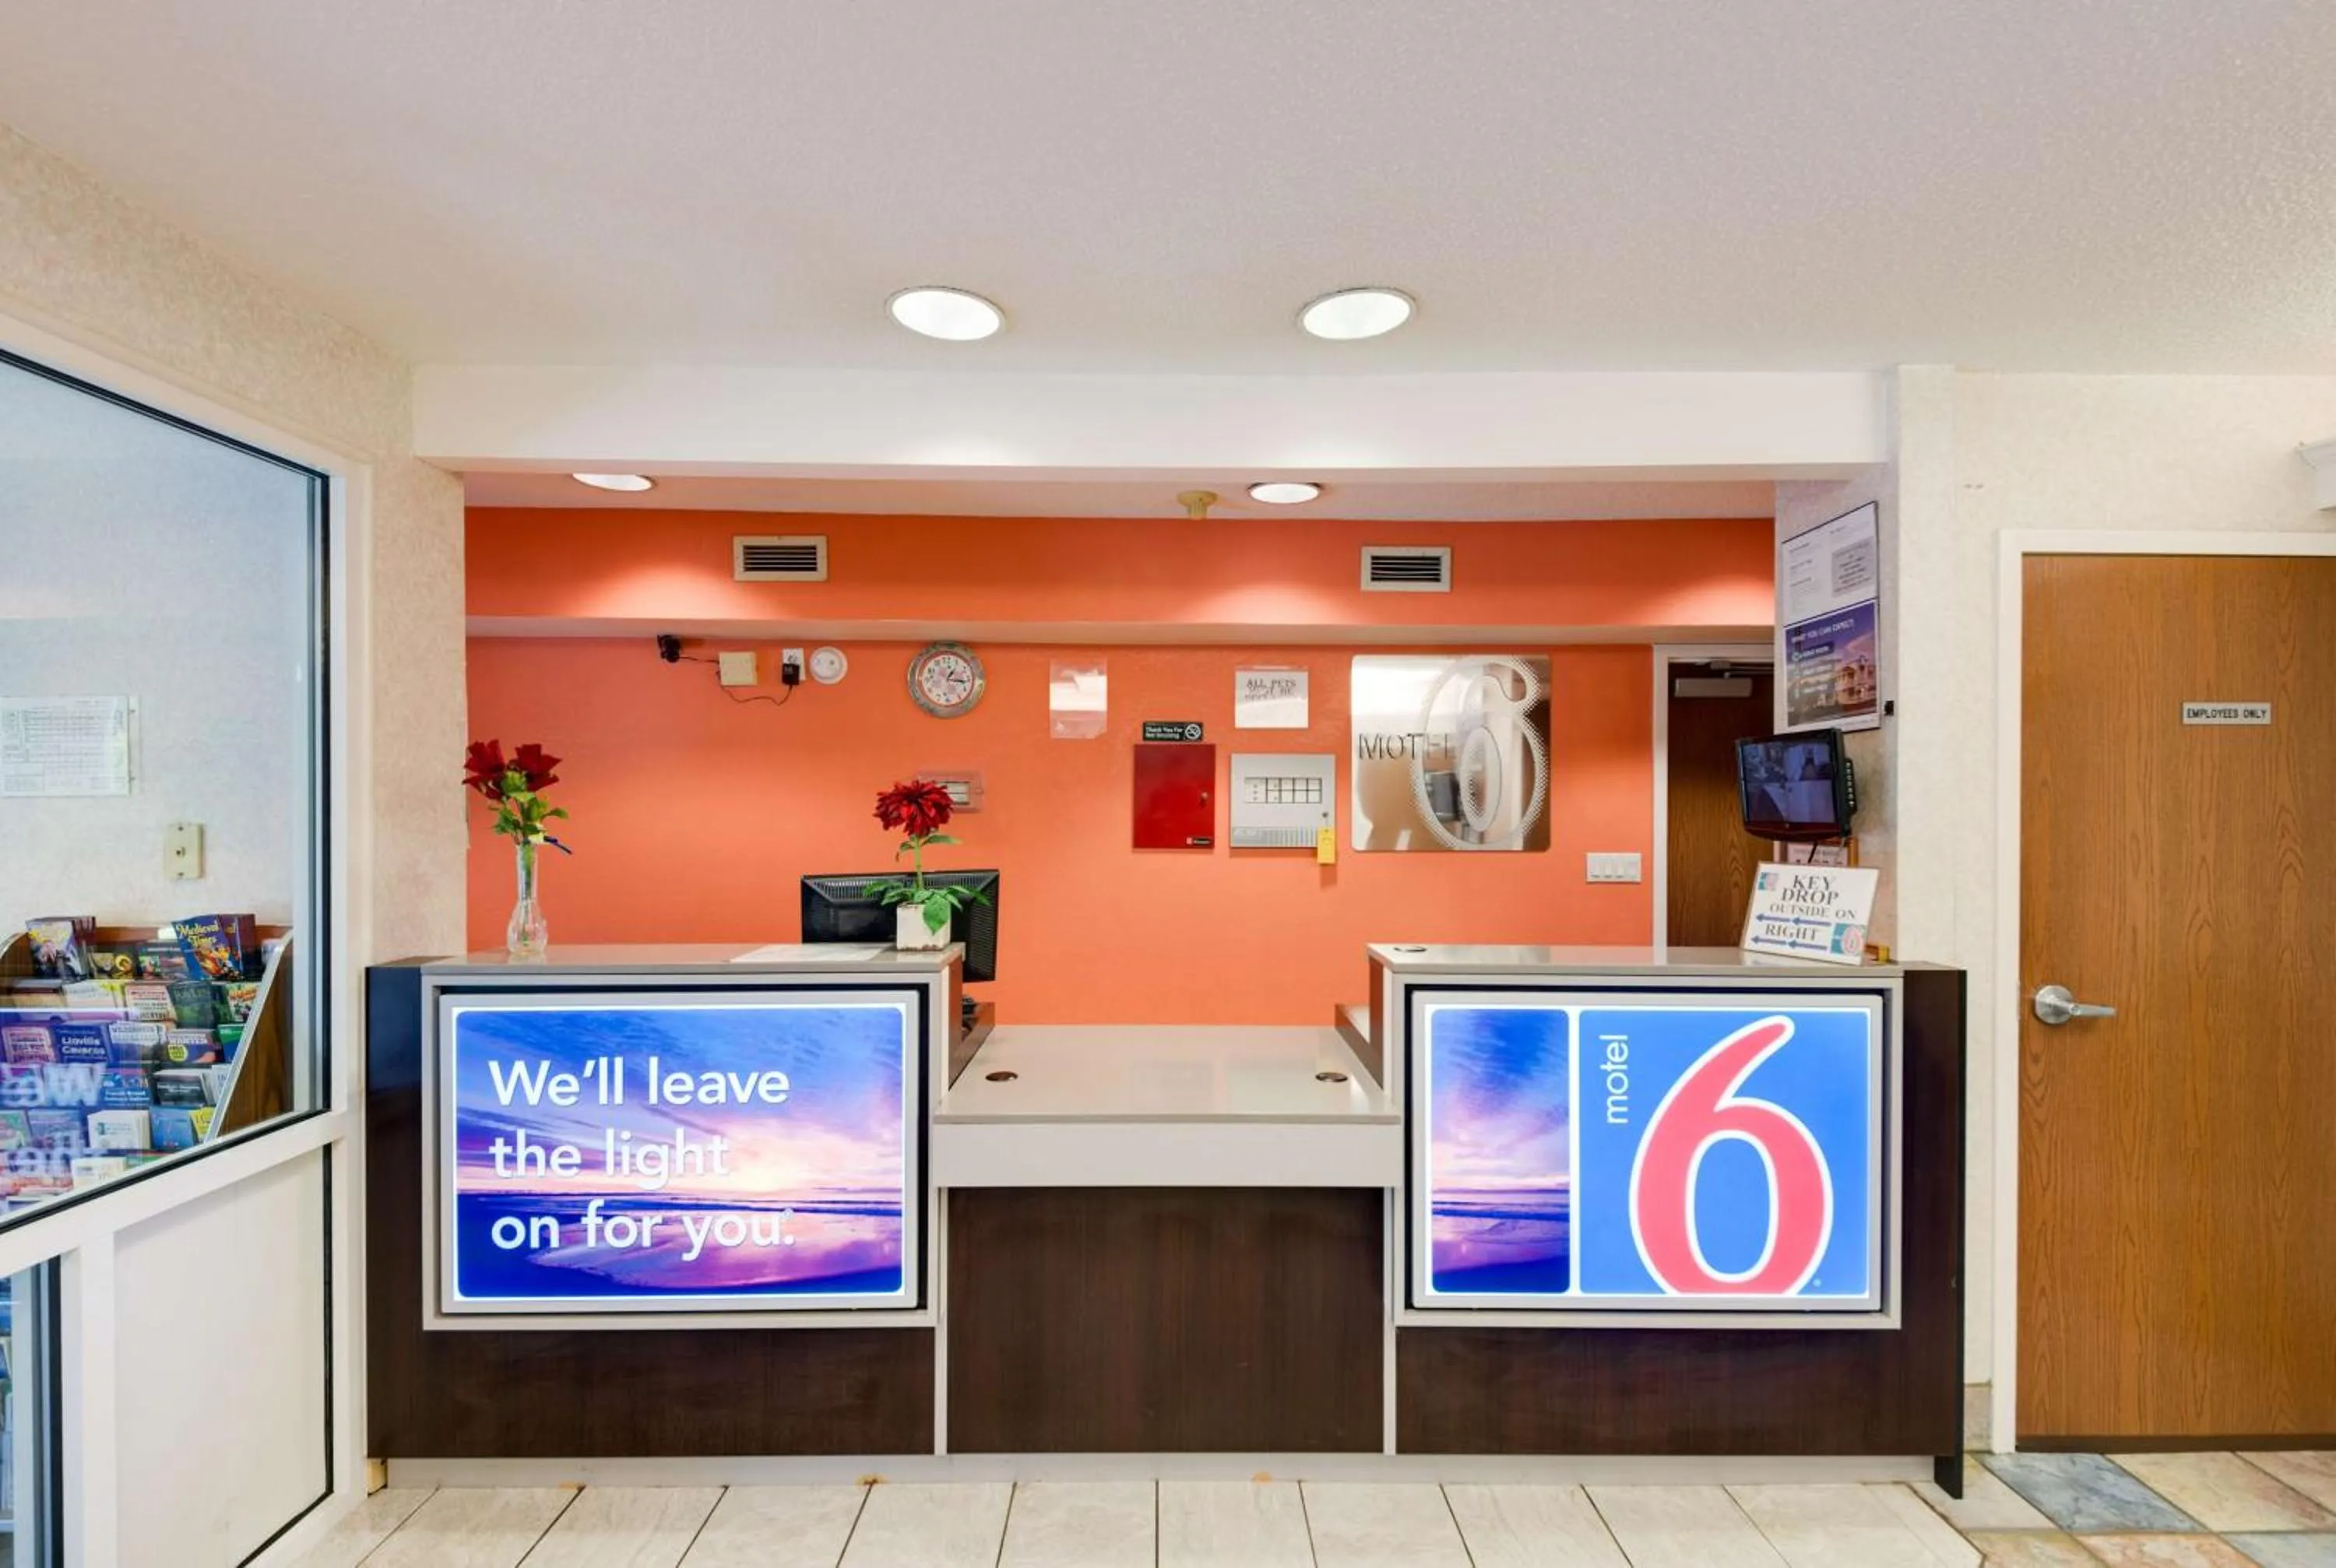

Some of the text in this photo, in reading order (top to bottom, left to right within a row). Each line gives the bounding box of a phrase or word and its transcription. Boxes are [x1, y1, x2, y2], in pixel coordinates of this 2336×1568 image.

[2186, 708, 2267, 719] EMPLOYEES ONLY
[1792, 874, 1832, 891] KEY
[1782, 888, 1839, 905] DROP
[1770, 902, 1858, 919] OUTSIDE ON
[1765, 923, 1820, 941] RIGHT
[62, 1036, 101, 1046] Linville
[62, 1046, 106, 1055] Caverns
[488, 1056, 790, 1106] We'll leave
[488, 1127, 729, 1190] the light
[1599, 1014, 1835, 1296] motel 6
[491, 1215, 560, 1250] on
[581, 1198, 663, 1249] for
